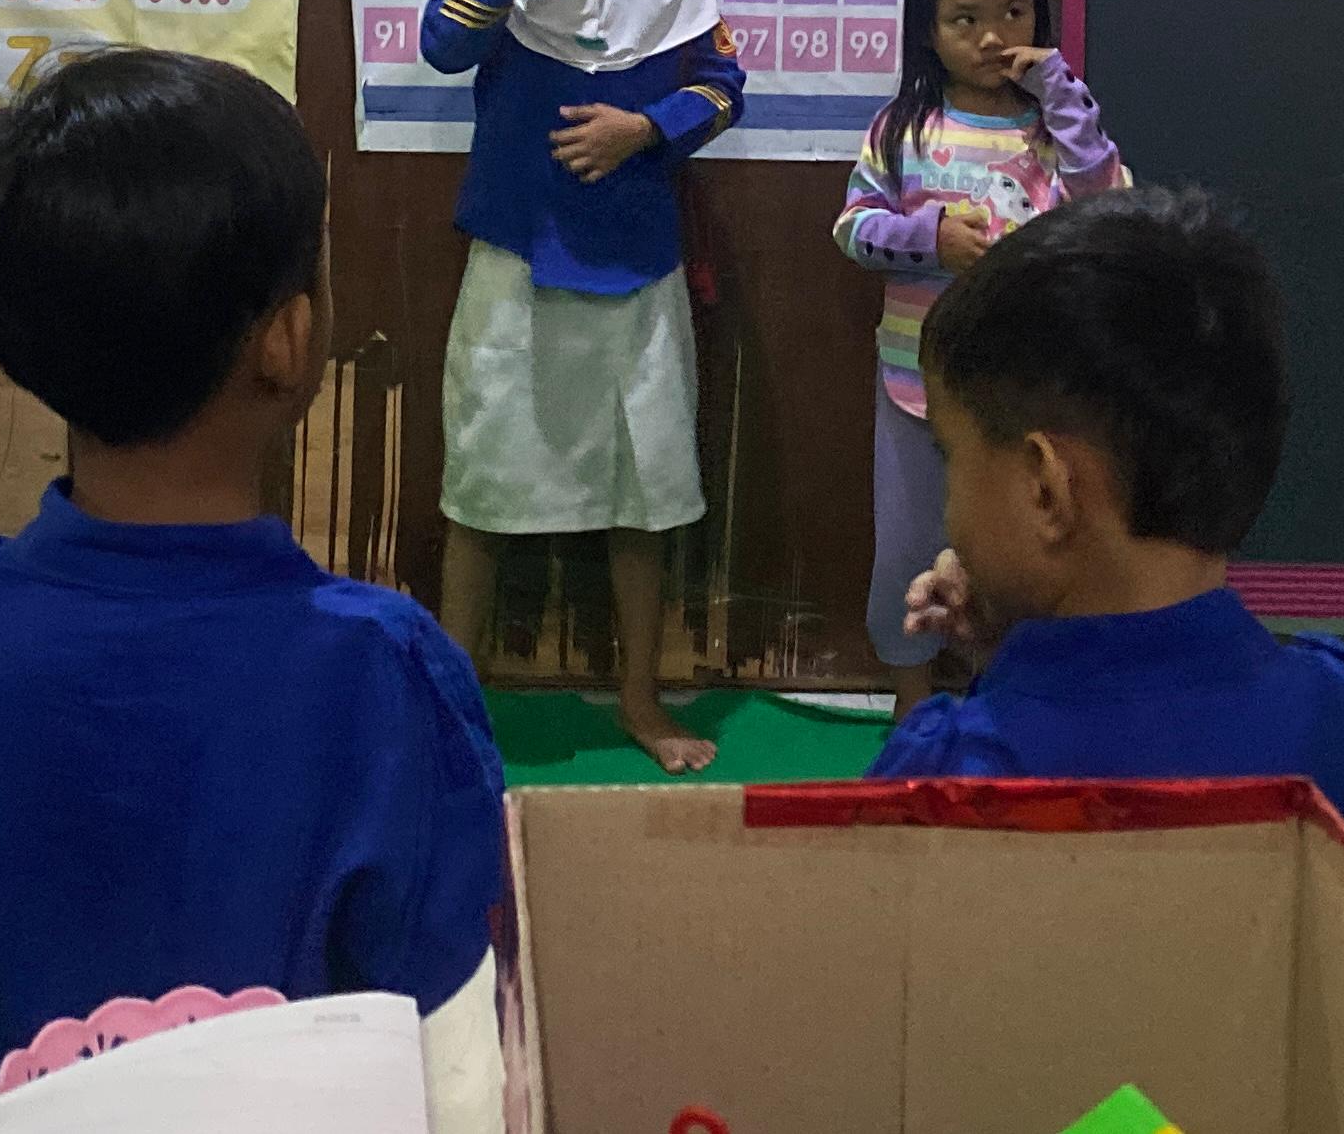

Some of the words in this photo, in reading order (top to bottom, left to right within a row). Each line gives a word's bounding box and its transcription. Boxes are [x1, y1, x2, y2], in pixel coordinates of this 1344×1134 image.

[375, 20, 406, 49] 91
[731, 29, 769, 57] 97
[790, 29, 829, 58] 98
[849, 30, 889, 59] 99
